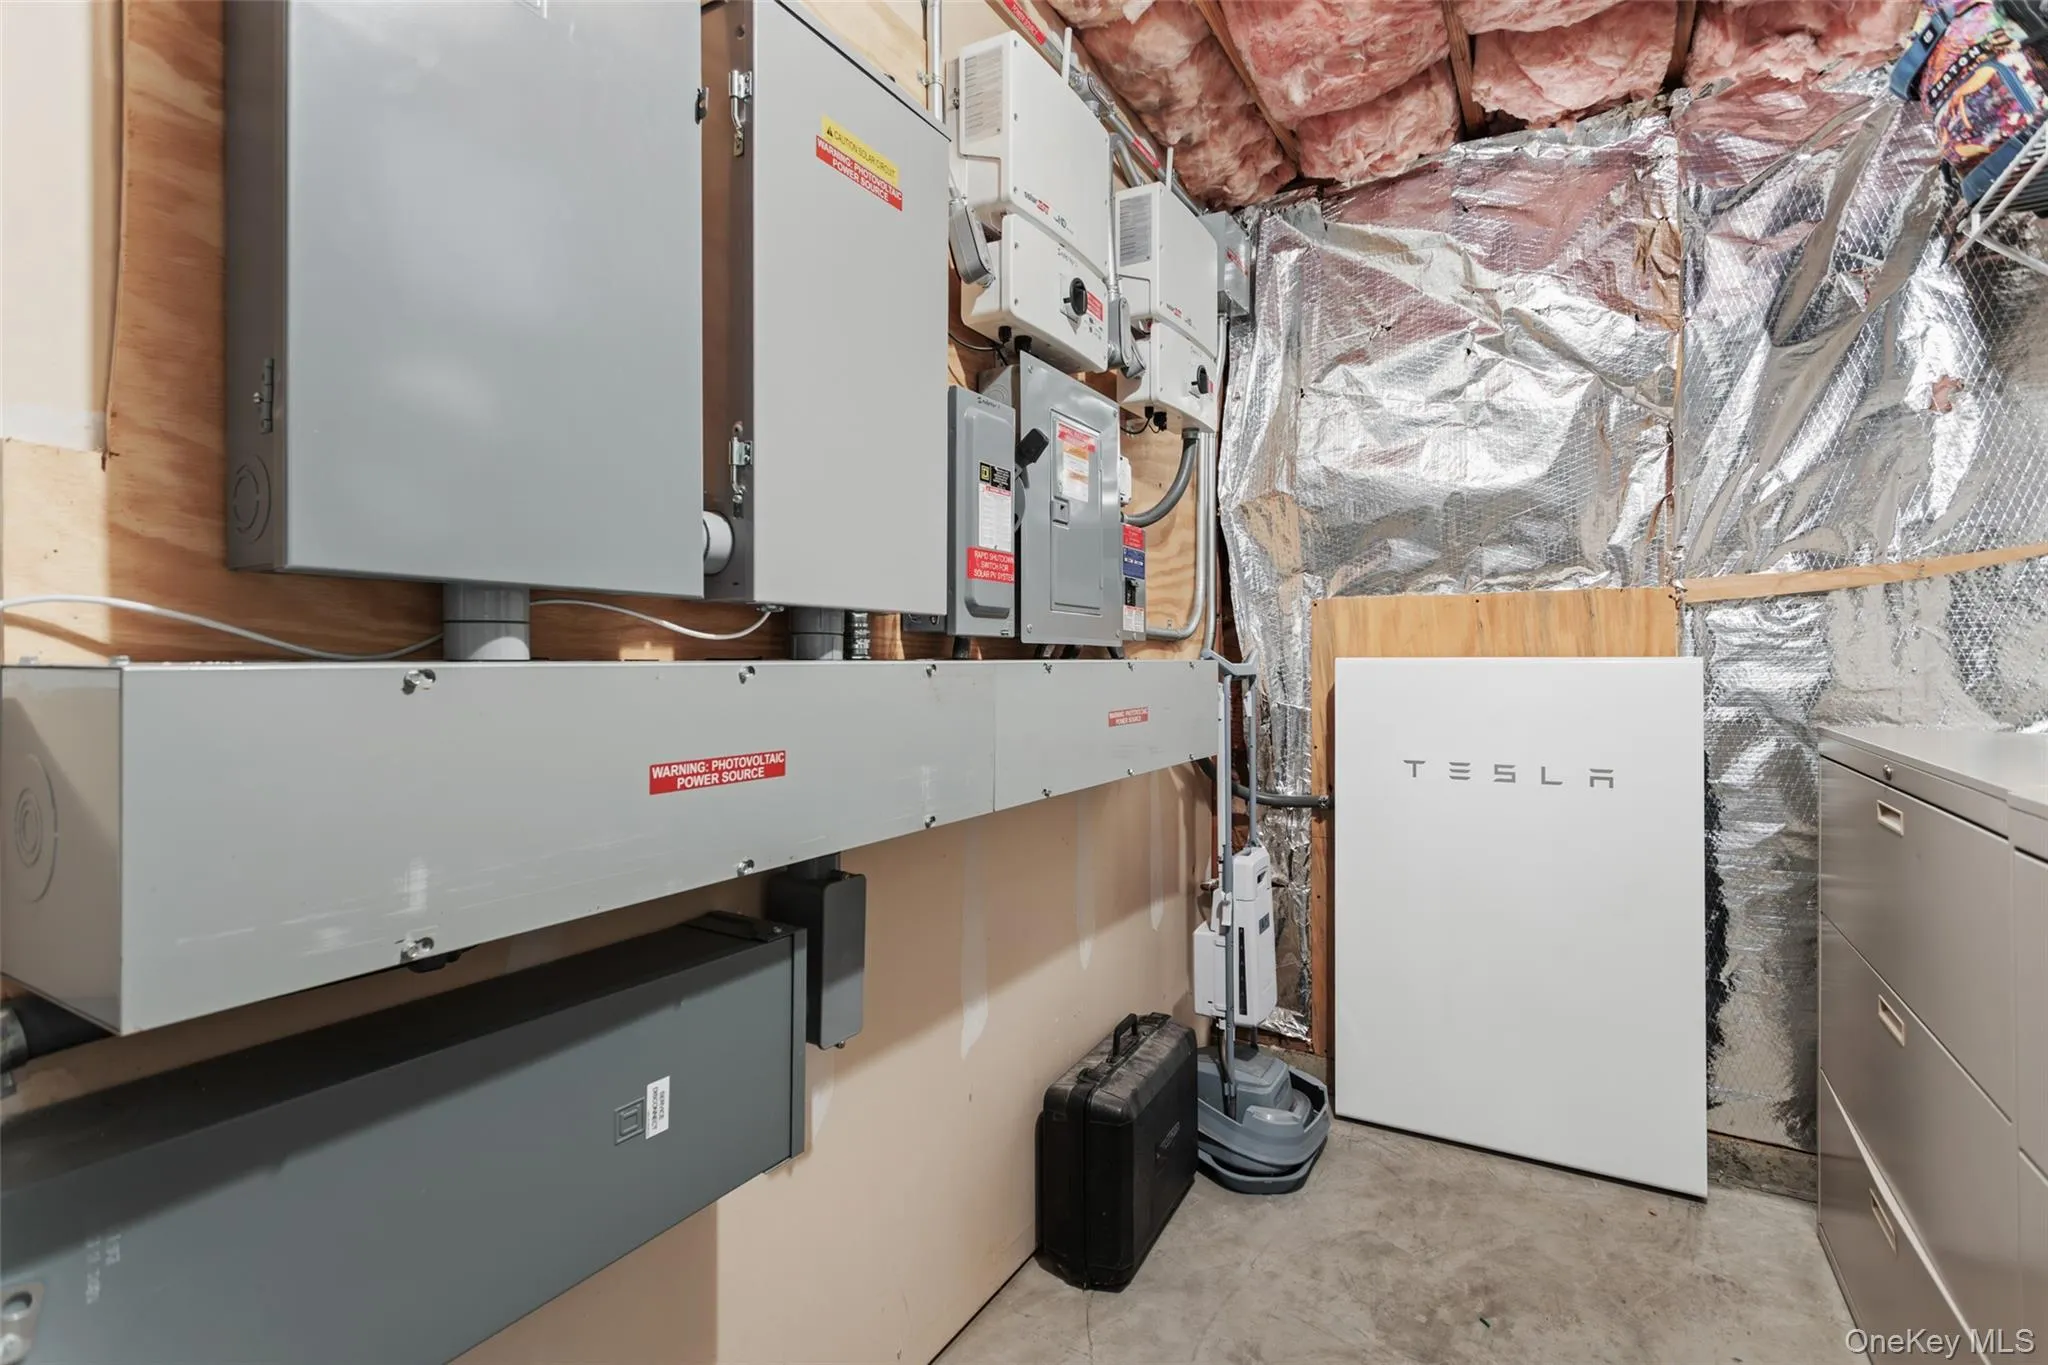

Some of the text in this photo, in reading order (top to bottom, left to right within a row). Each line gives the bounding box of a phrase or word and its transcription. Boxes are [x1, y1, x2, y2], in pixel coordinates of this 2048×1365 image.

[1930, 46, 1980, 98] BURTON
[817, 139, 902, 201] WARNING: PHOTOVOLTAIC
[832, 160, 889, 201] POWER SOURCE
[974, 550, 988, 561] RAPID
[974, 568, 990, 578] SOLAR
[652, 752, 785, 779] WARNING: PHOTOVOLTAIC
[676, 766, 765, 789] POWER SOURCE
[1403, 759, 1614, 789] TESLA
